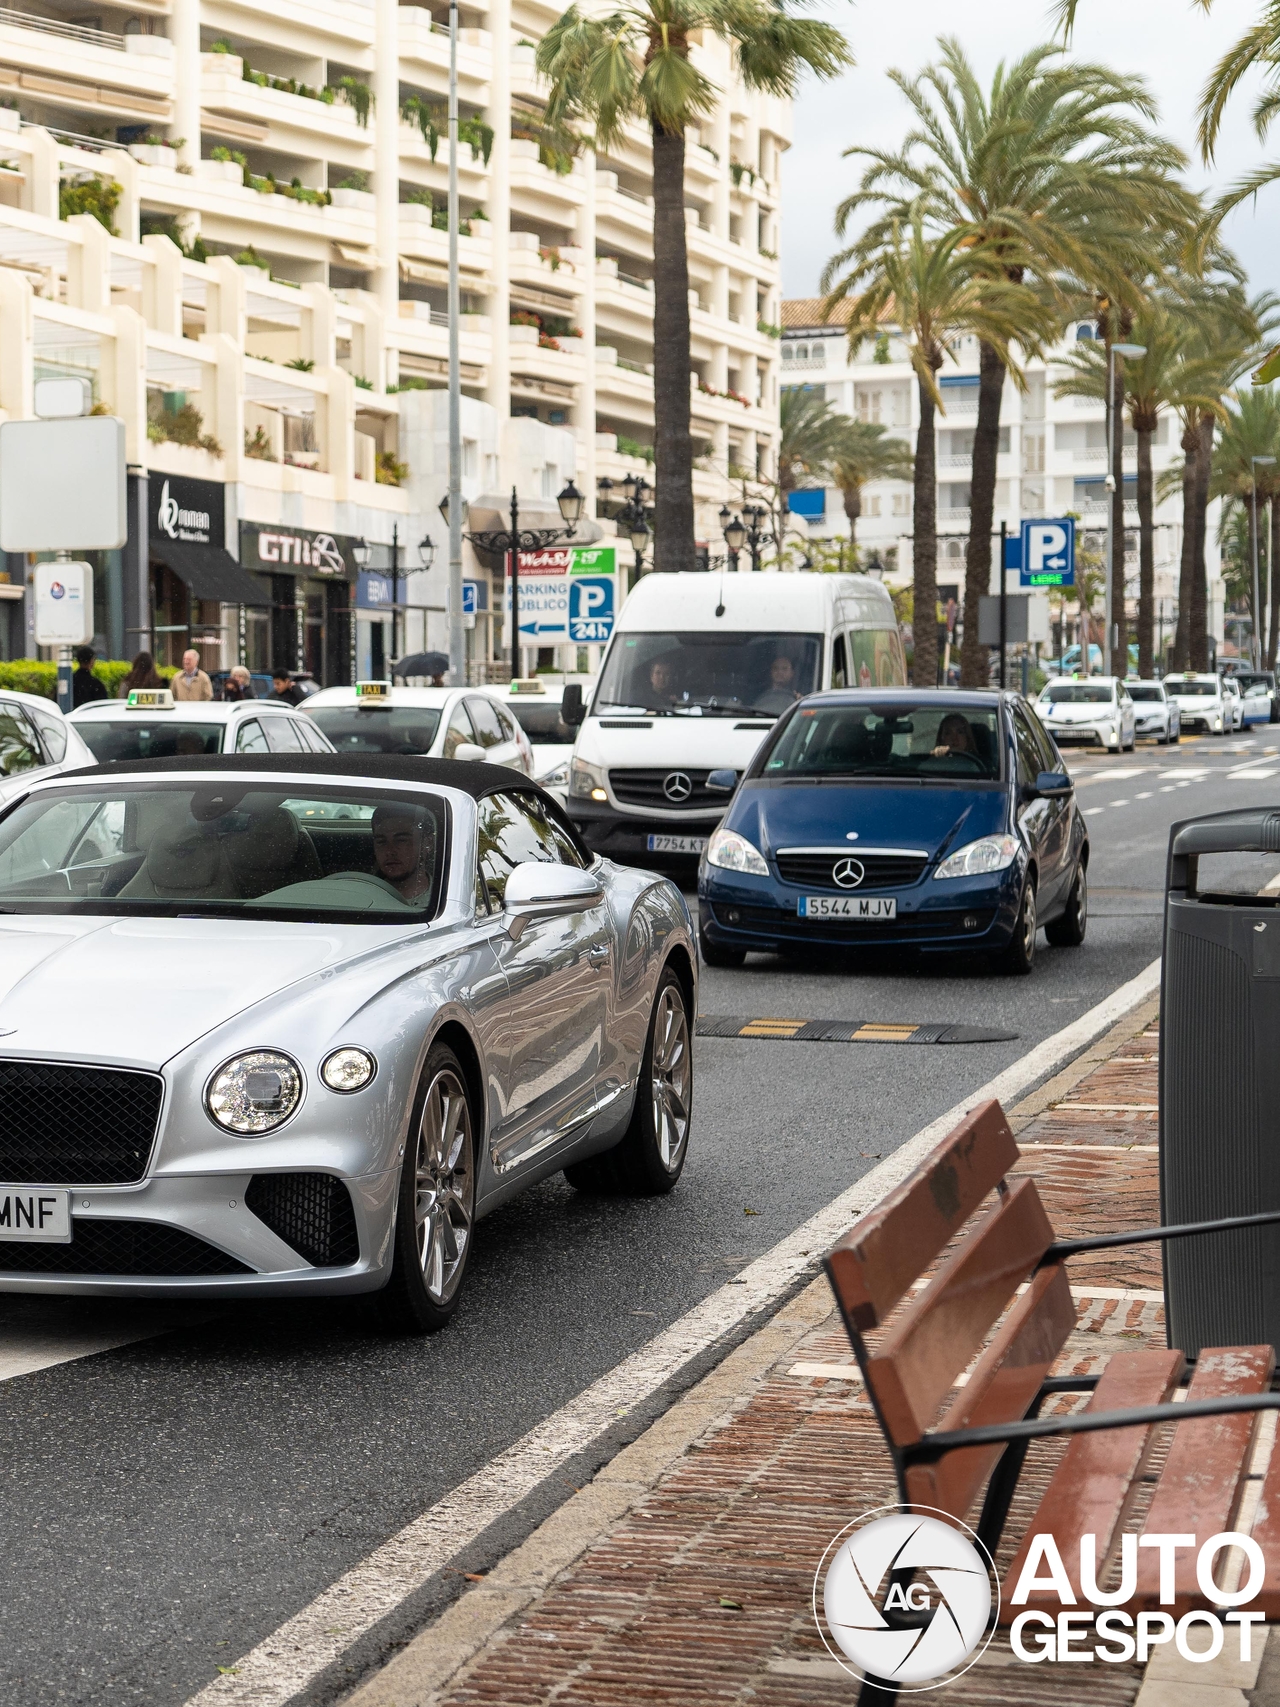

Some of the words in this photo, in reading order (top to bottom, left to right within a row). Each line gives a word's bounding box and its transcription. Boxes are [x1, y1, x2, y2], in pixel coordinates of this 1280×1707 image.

[258, 532, 301, 566] GTI
[1029, 525, 1067, 571] P
[508, 583, 567, 595] PARKING
[578, 585, 606, 618] P
[575, 622, 608, 639] 24h
[656, 837, 686, 850] 7754
[810, 900, 851, 915] 5544
[859, 900, 893, 916] MJV
